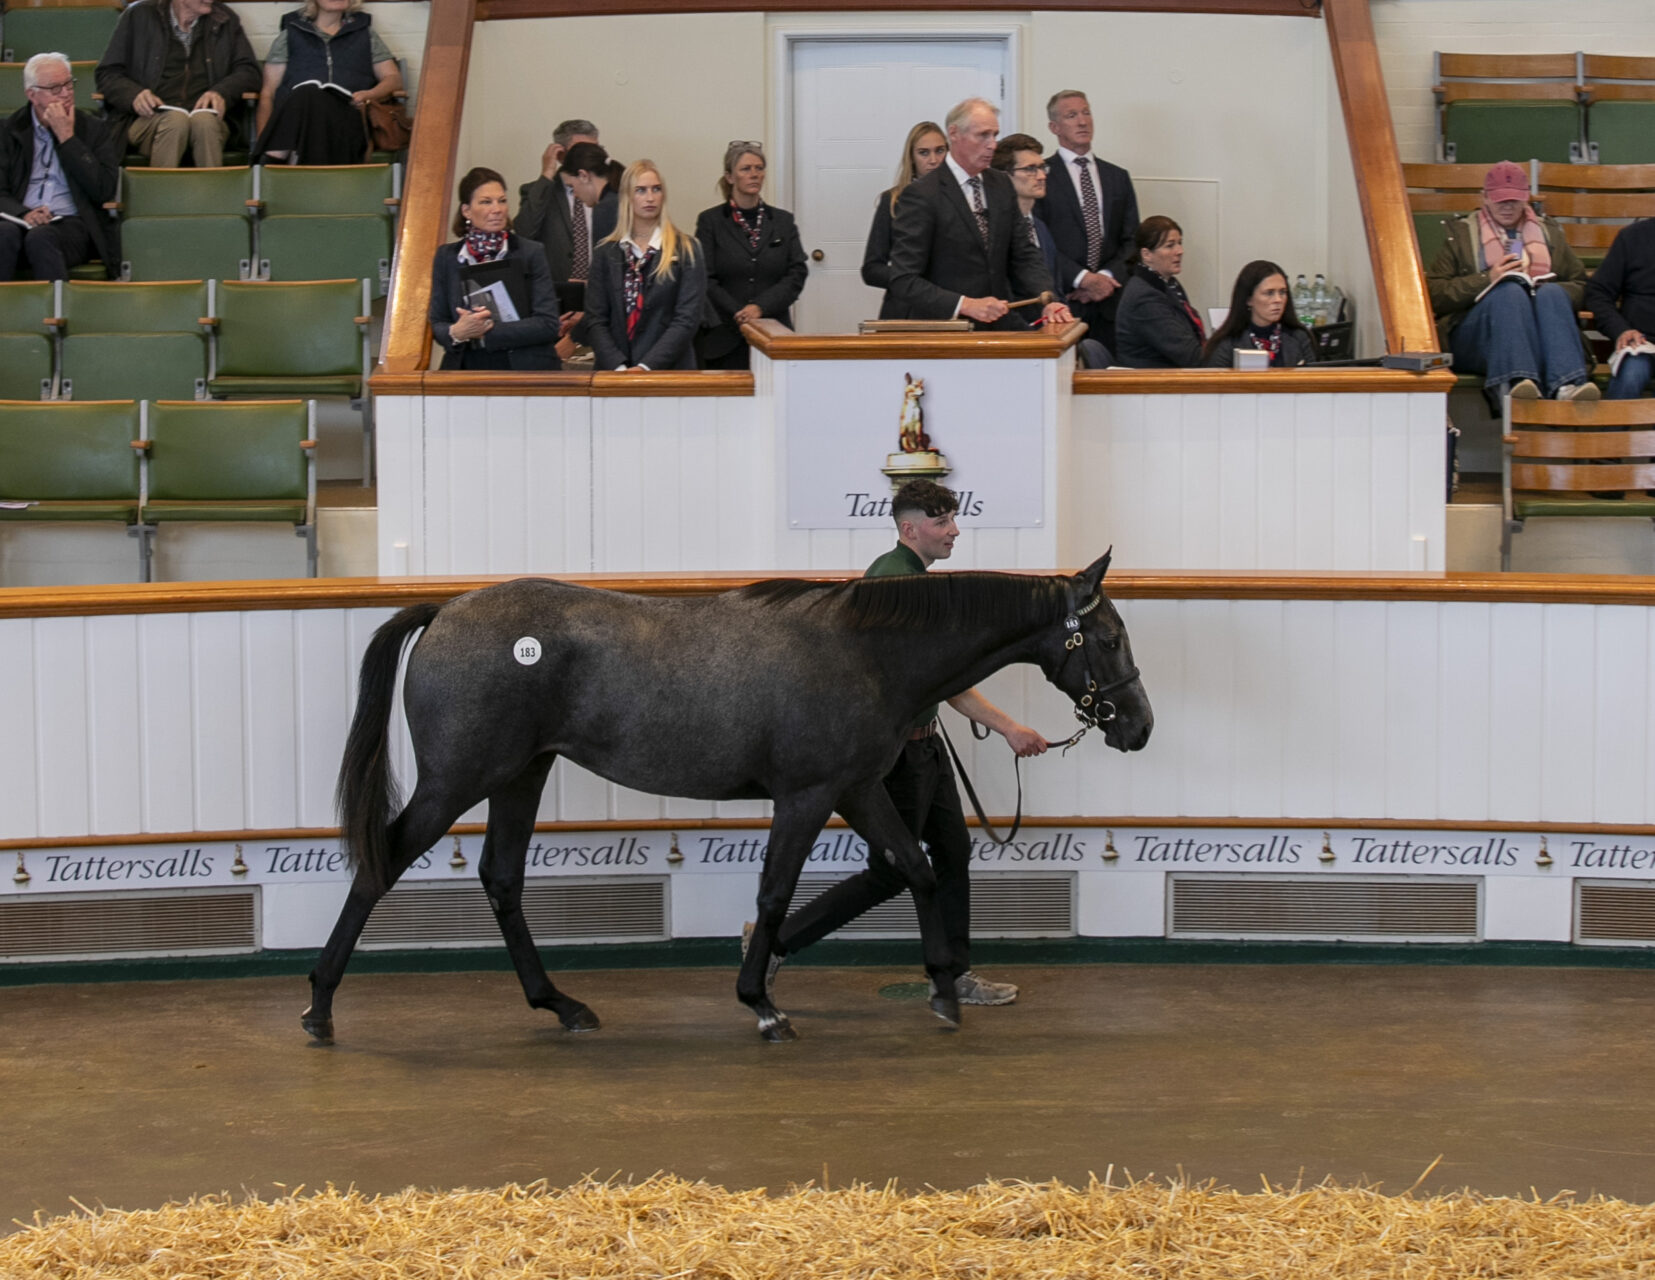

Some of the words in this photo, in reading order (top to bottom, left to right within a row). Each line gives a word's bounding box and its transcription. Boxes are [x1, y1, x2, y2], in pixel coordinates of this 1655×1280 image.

[845, 491, 984, 517] Tatlls
[520, 647, 536, 658] 183
[265, 846, 433, 873] Tattes
[525, 836, 650, 867] tersalls
[699, 829, 867, 864] Tattalls
[970, 827, 1087, 862] tersalls
[1134, 835, 1302, 863] Tattersalls
[1352, 836, 1518, 866] Tattersalls
[46, 849, 214, 882] Tattersalls
